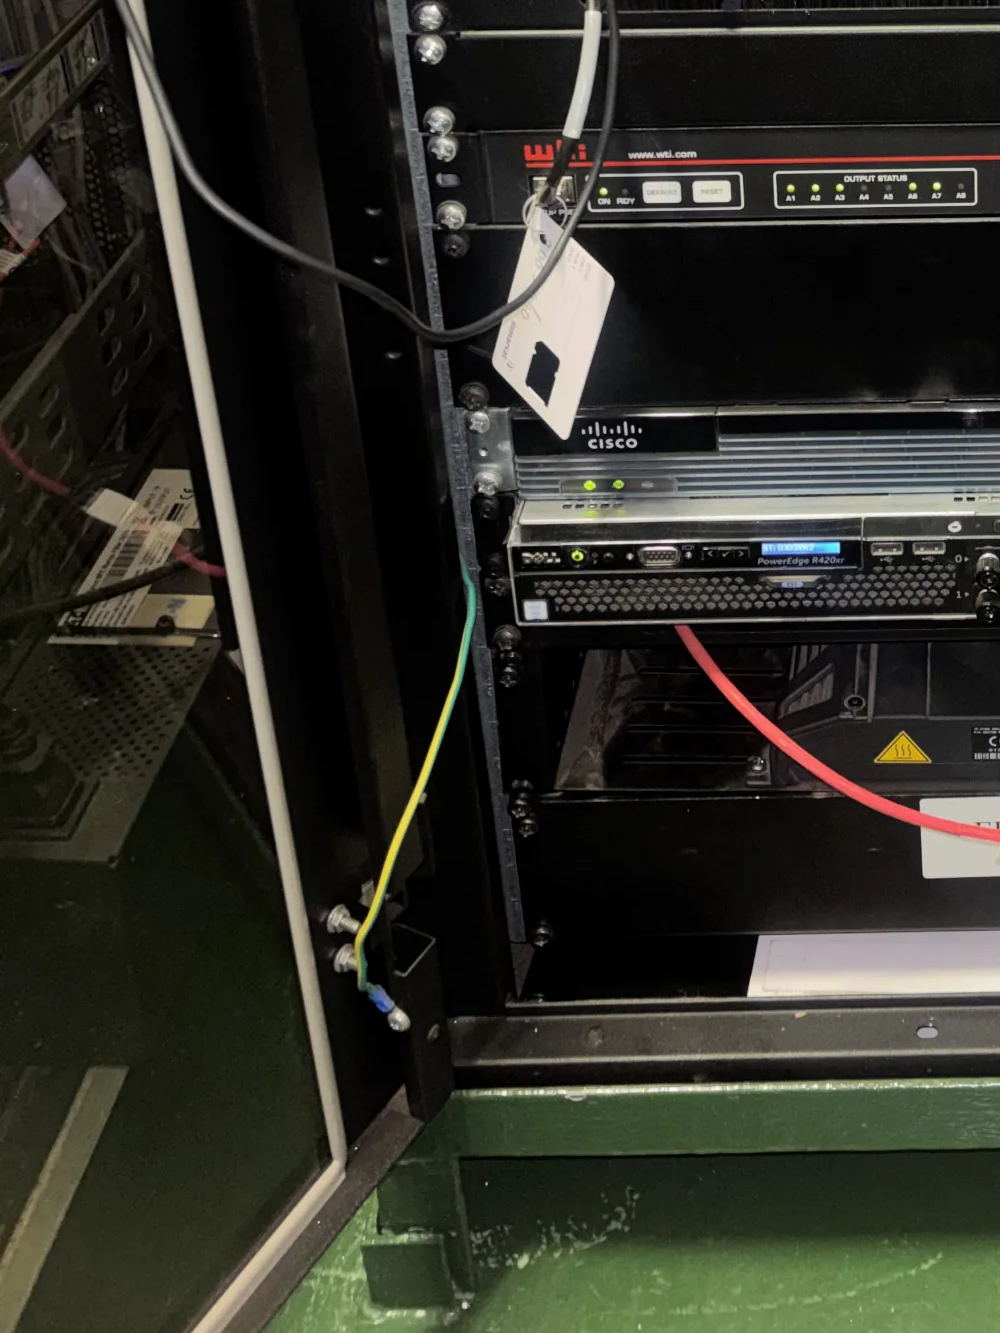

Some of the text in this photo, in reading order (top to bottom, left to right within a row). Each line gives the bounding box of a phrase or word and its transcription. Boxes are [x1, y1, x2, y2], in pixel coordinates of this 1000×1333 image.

[628, 149, 697, 161] www.wti.com
[843, 174, 908, 183] OUTPUT STATUS
[646, 188, 678, 197] DEFAULT
[700, 187, 723, 196] RESET
[597, 197, 635, 206] ON RDY
[785, 194, 796, 202] A1
[810, 193, 821, 202] A2
[834, 193, 846, 201] A3
[859, 193, 870, 201] A4
[907, 192, 918, 200] A6
[931, 192, 943, 200] A7
[588, 438, 638, 450] CISCO
[521, 551, 562, 565] DELL
[757, 556, 845, 567] PowerEdge R420xr
